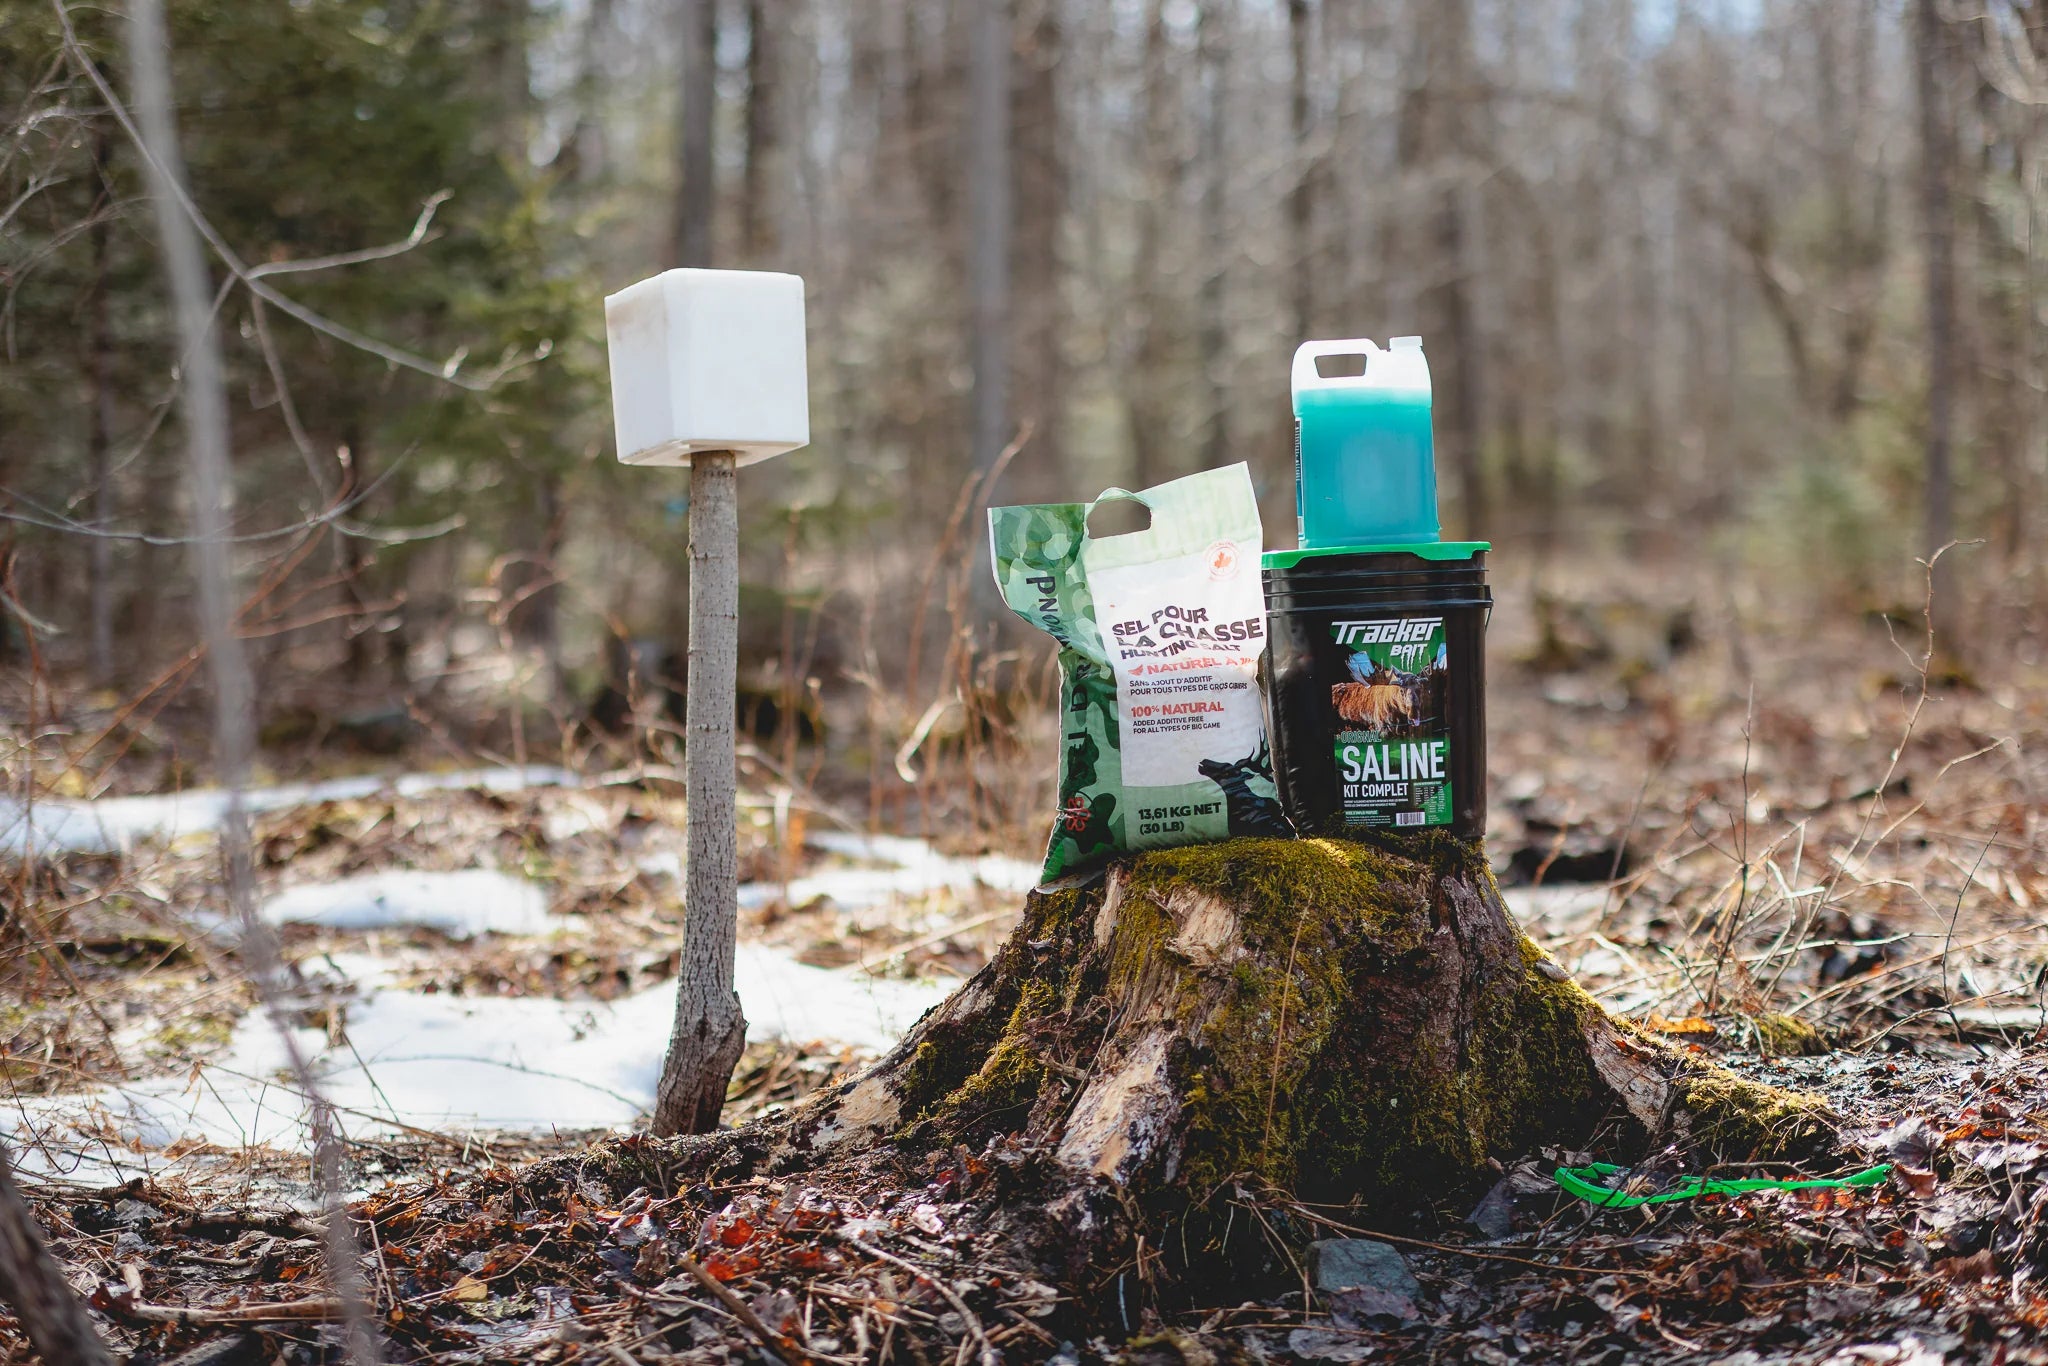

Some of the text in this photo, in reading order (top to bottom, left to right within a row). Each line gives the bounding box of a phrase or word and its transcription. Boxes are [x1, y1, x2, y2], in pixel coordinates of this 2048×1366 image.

[1112, 605, 1209, 636] SEL POUR
[1116, 617, 1264, 648] LA CHASSE
[1331, 617, 1443, 645] Tracker
[1121, 639, 1199, 660] HUNTING
[1389, 643, 1428, 662] BAIT
[1146, 657, 1222, 675] NATUREL
[1130, 687, 1151, 696] POUR
[1153, 686, 1172, 694] TOUS
[1174, 685, 1197, 693] TYPES
[1198, 684, 1207, 692] DE
[1209, 682, 1228, 691] GROS
[1177, 675, 1213, 685] D'ADDITIF
[1131, 701, 1224, 718] 100% NATURAL
[1133, 715, 1204, 727] ADDED ADDITIVE FREE
[1133, 727, 1147, 735] FOR
[1147, 726, 1159, 734] ALL
[1160, 725, 1181, 733] TYPES
[1342, 741, 1446, 783] SALINE
[1343, 783, 1409, 798] KIT COMPLET
[1138, 802, 1222, 820] 13,61 KG NET
[1139, 821, 1184, 835] (30 LB)
